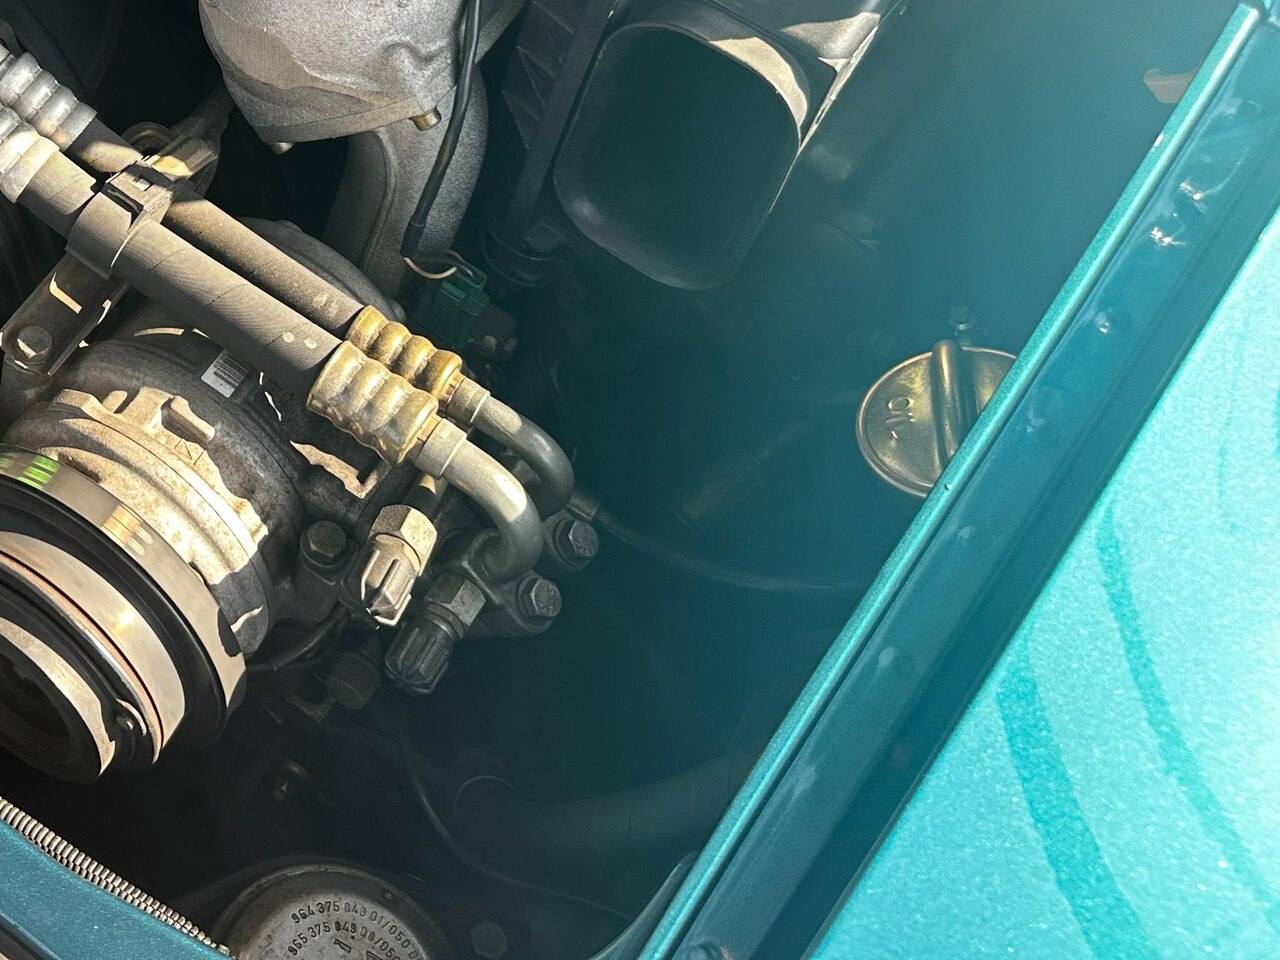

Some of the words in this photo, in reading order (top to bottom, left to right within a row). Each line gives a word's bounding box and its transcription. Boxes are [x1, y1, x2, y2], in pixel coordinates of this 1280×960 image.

[886, 395, 915, 439] OIL
[291, 905, 315, 923] 964
[317, 901, 340, 914] 375
[288, 933, 308, 956] 965
[308, 921, 331, 938] 375
